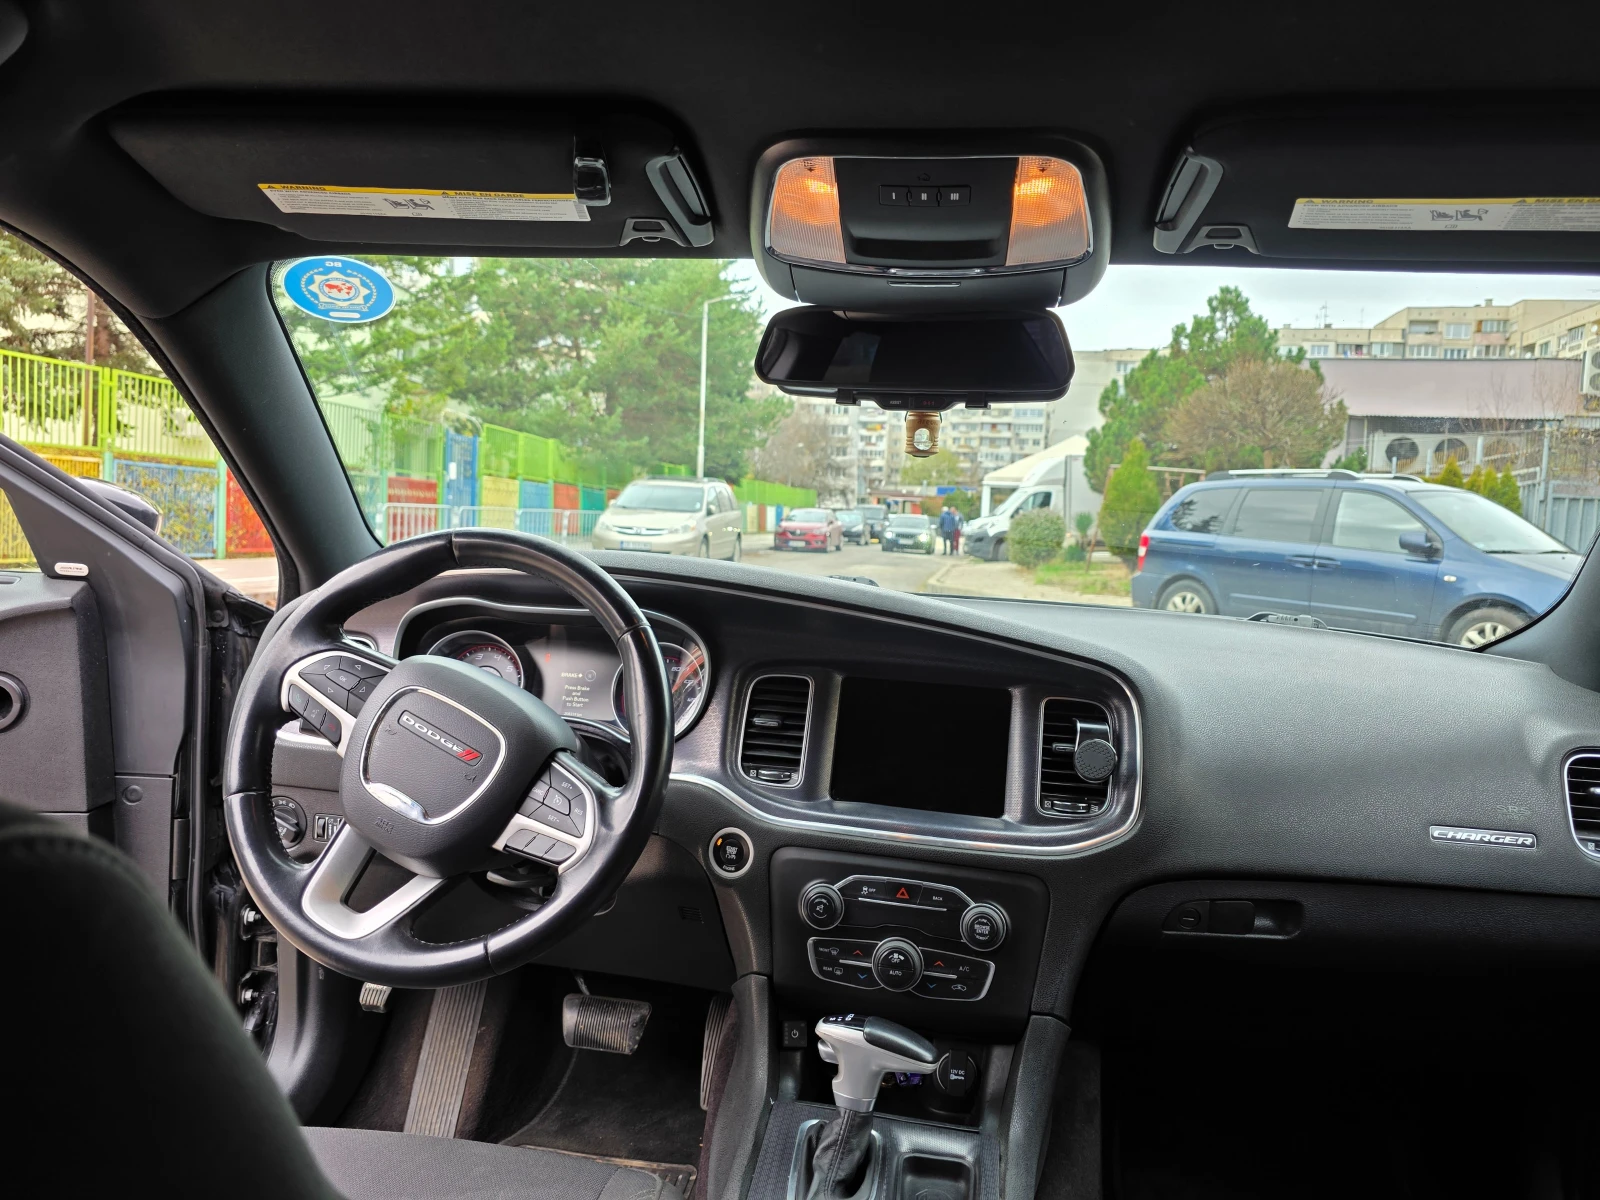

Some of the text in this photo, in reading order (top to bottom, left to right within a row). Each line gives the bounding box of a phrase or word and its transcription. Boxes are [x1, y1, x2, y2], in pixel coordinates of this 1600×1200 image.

[506, 665, 514, 673] 5
[403, 715, 464, 753] DODGE
[1497, 804, 1531, 815] SRS
[1433, 830, 1533, 846] CHARGER
[958, 965, 970, 973] A/C
